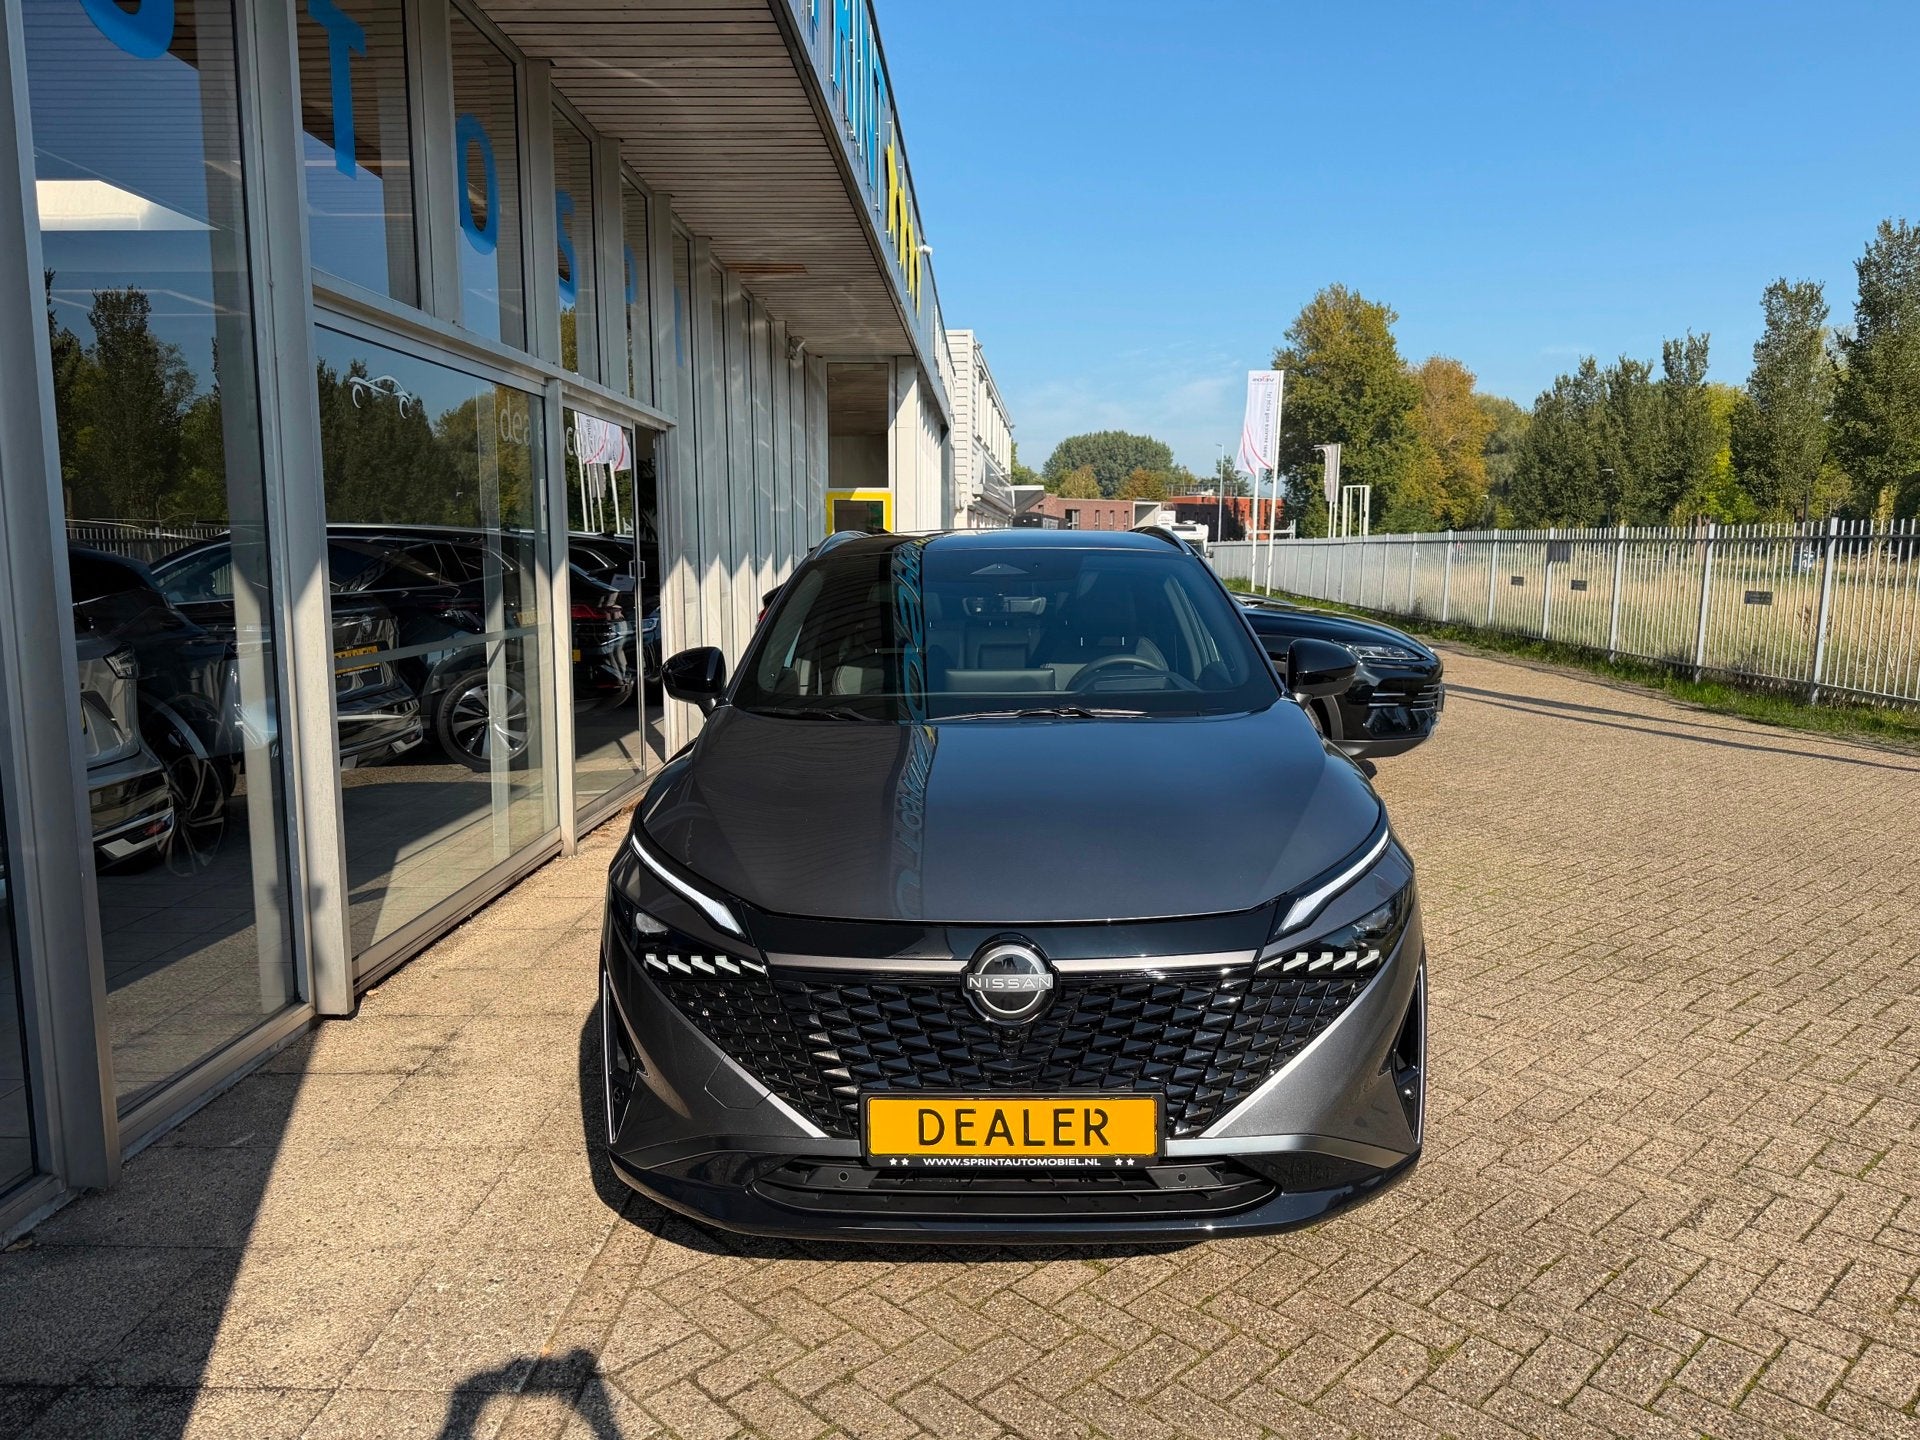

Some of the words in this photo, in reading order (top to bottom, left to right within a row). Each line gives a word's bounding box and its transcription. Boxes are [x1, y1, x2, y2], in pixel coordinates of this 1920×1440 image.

[969, 976, 1051, 989] NISSAN
[918, 1108, 1110, 1147] DEALER
[923, 1158, 1101, 1167] WWW.SPRINTAUTOMOBIEL.NL
